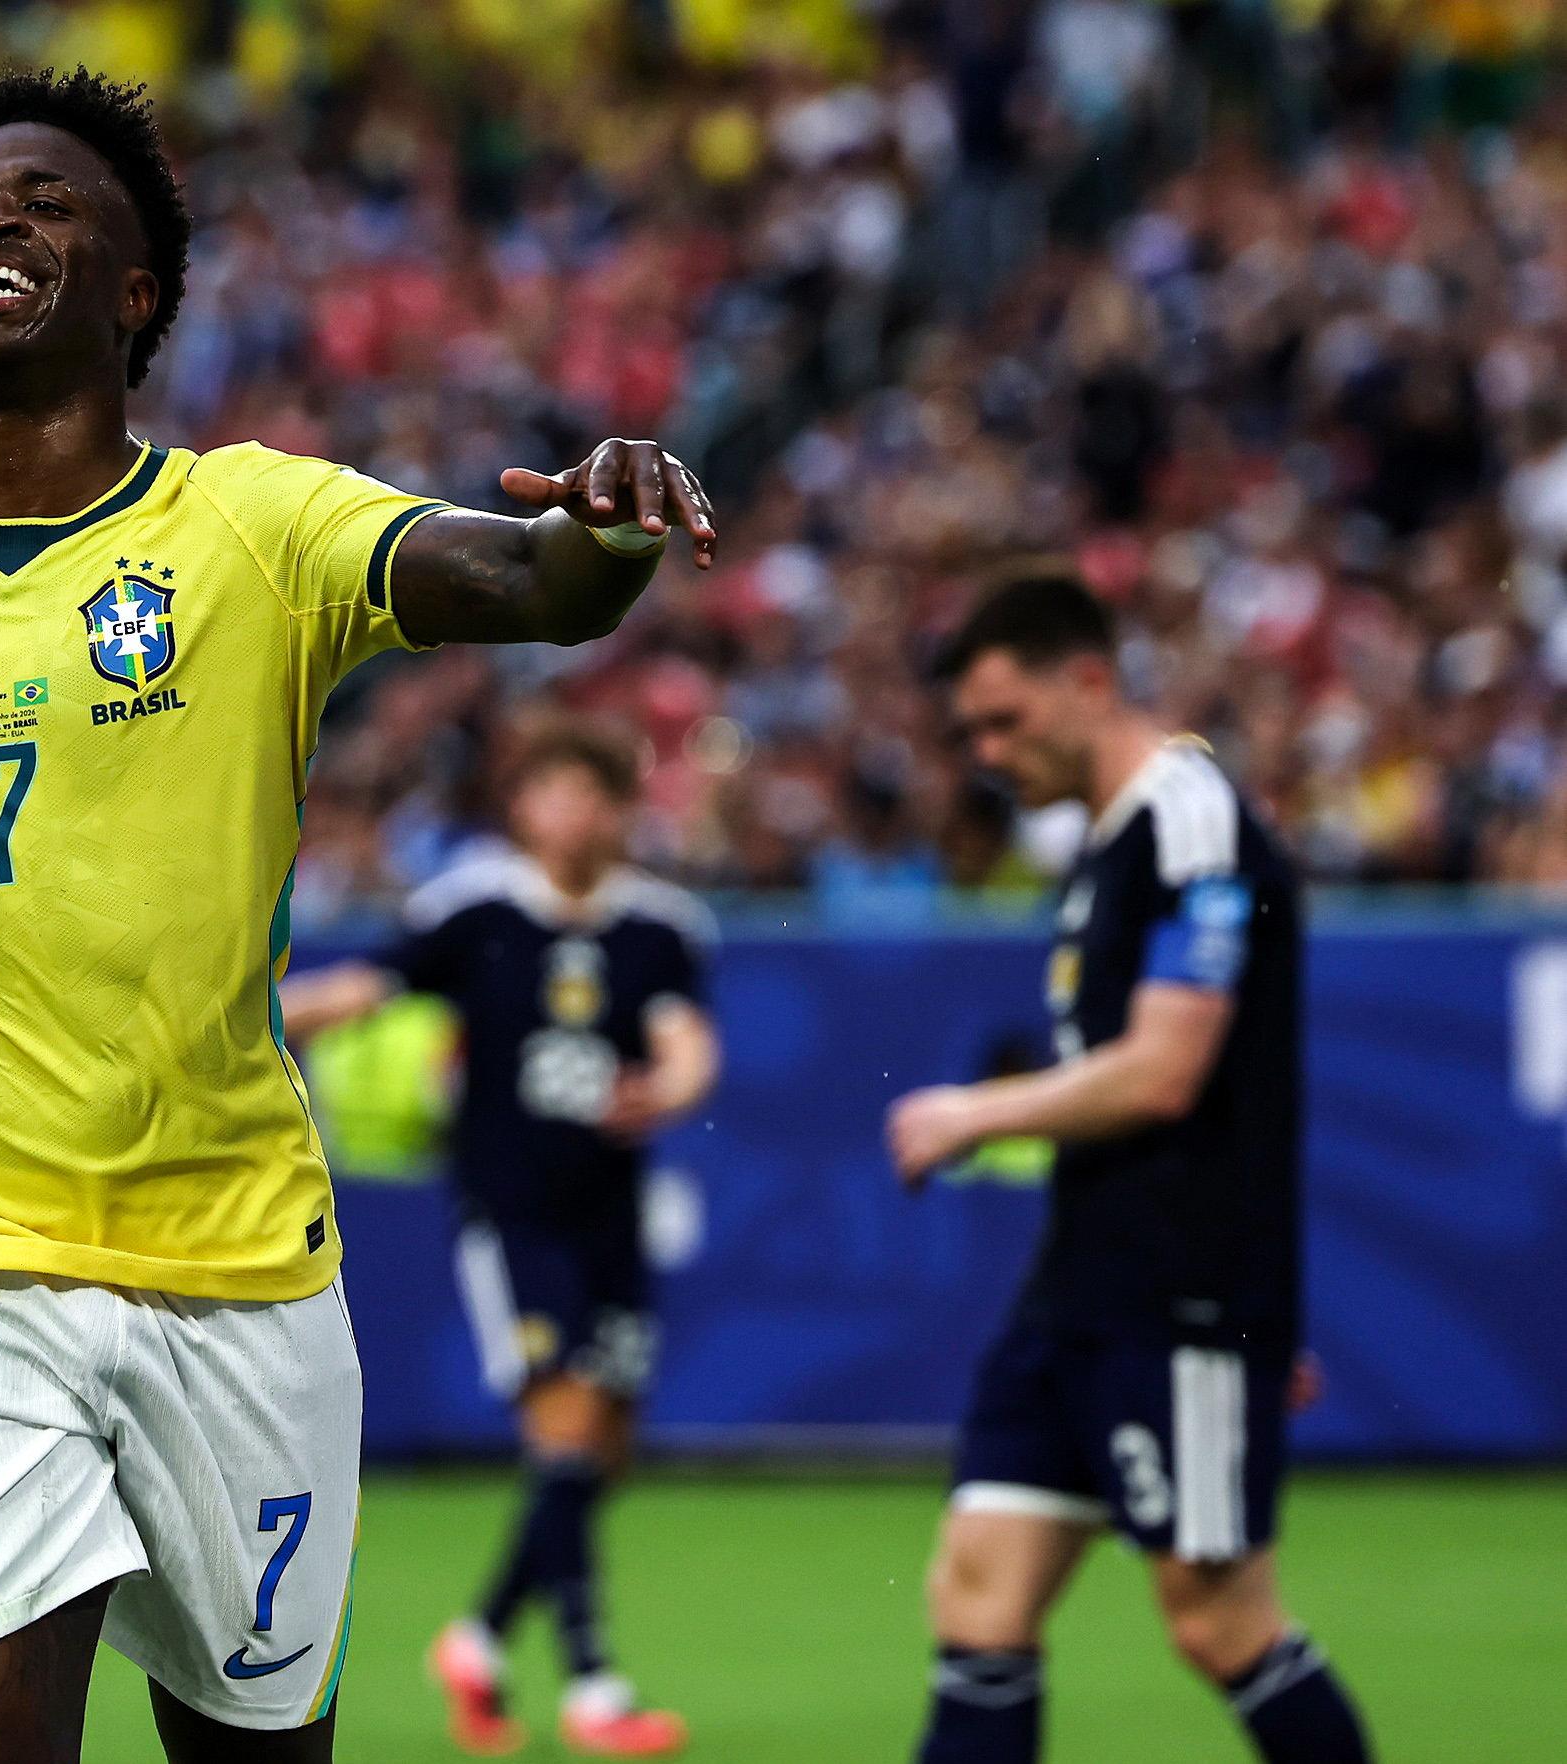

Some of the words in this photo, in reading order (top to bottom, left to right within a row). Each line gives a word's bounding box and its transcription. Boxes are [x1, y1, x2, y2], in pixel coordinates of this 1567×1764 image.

[113, 620, 146, 636] CBF
[20, 709, 35, 717] 2026
[91, 688, 186, 725] BRASIL
[14, 718, 38, 728] BRASIL
[1109, 1422, 1171, 1527] 3
[252, 1490, 312, 1631] 7
